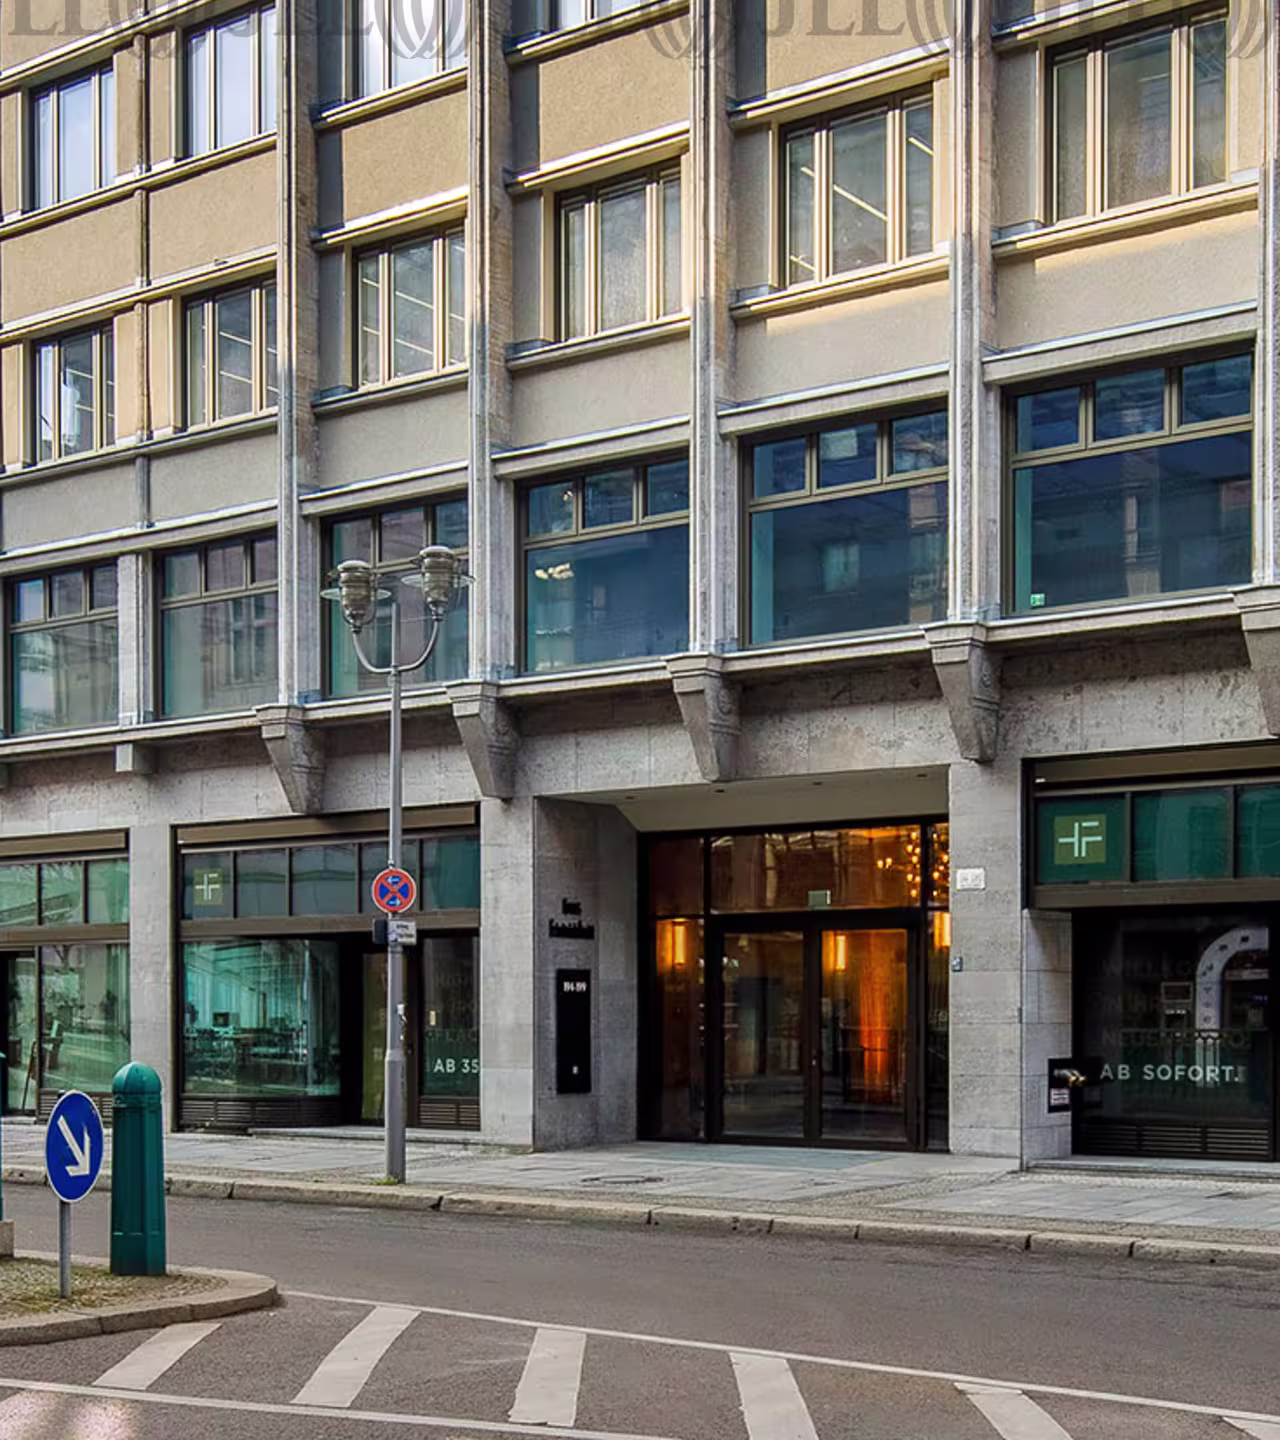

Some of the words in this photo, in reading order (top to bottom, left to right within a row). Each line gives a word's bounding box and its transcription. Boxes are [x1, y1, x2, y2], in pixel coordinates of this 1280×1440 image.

[433, 1058, 456, 1074] AB
[1099, 1064, 1131, 1081] AB
[1142, 1064, 1240, 1083] SOFORT.
